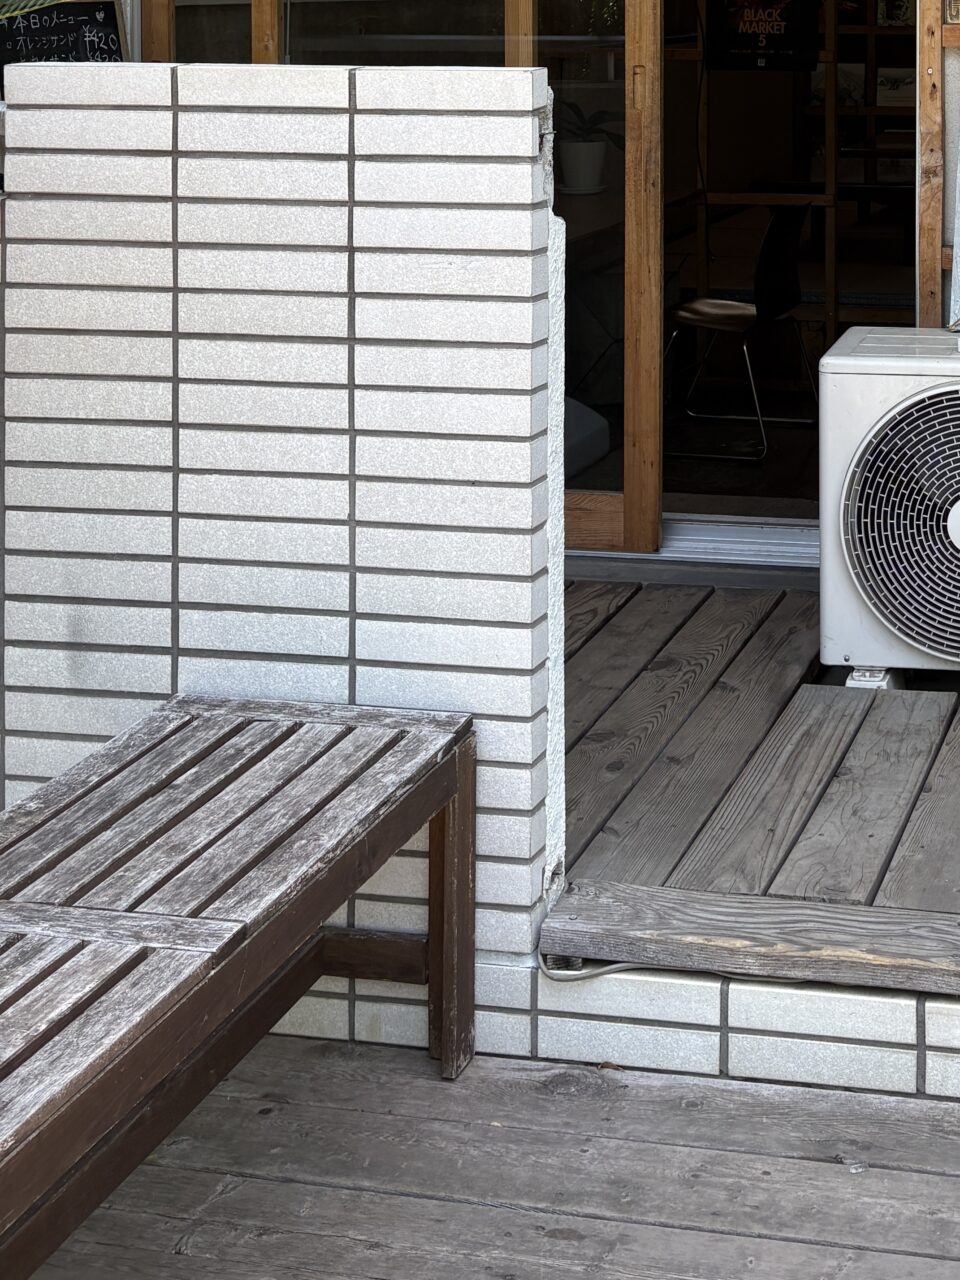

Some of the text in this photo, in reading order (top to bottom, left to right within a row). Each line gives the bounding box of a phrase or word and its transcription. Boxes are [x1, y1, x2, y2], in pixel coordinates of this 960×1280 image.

[743, 8, 782, 22] BLACK
[738, 22, 787, 35] MARKET
[757, 34, 767, 47] 5
